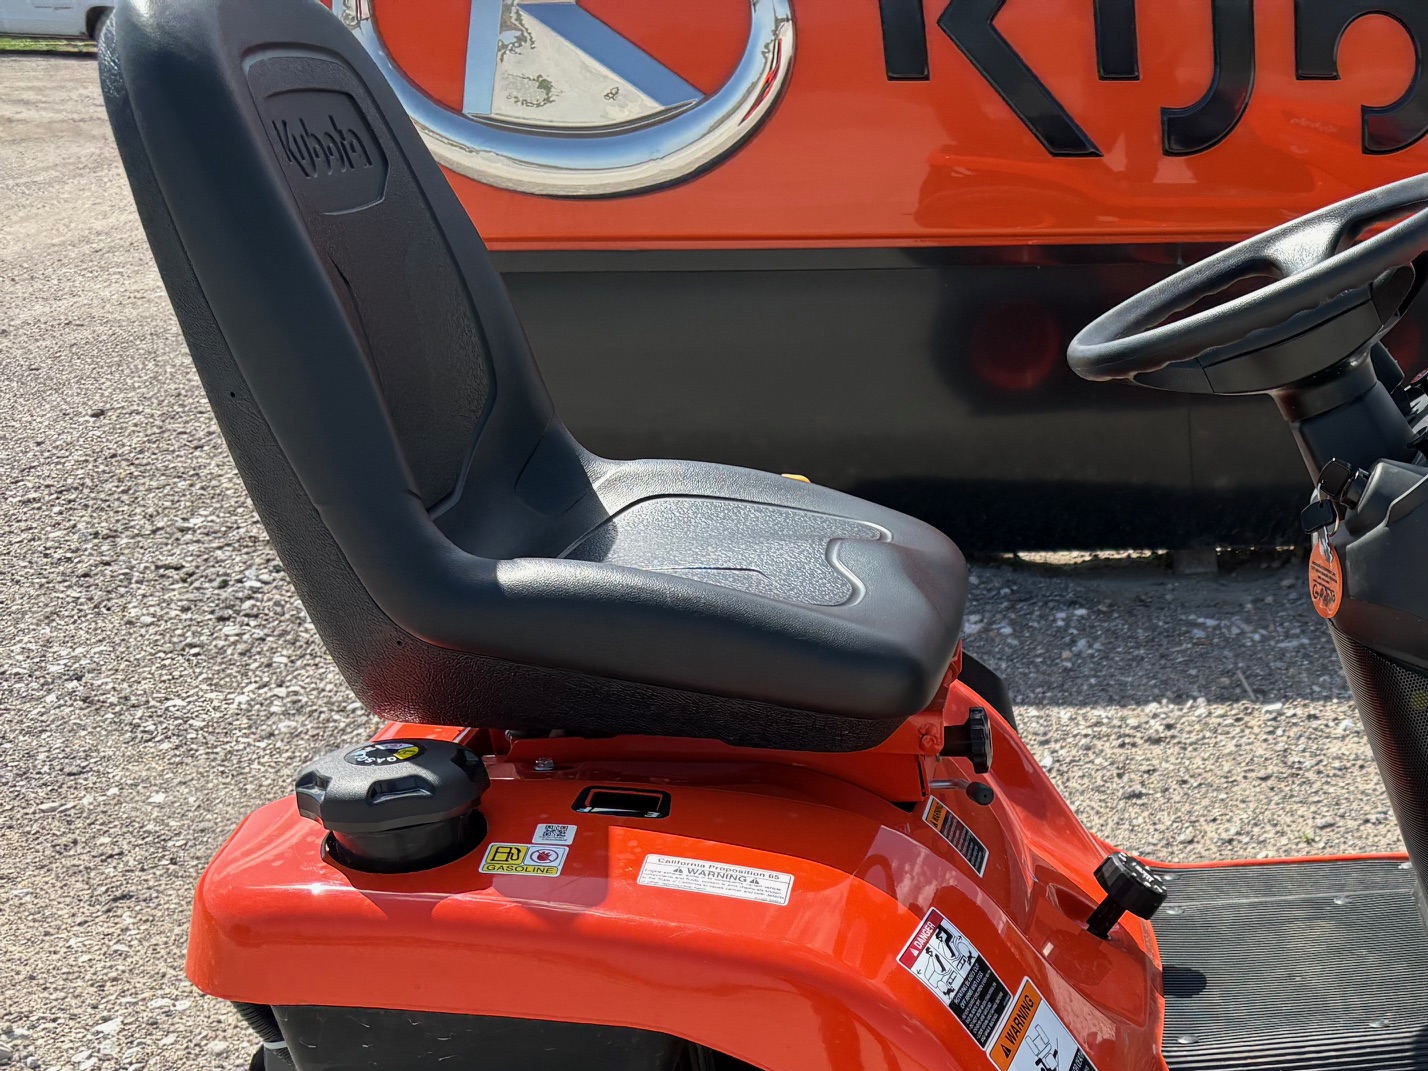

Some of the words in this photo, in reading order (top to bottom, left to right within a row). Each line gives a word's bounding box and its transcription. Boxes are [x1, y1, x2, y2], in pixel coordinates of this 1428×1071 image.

[271, 114, 374, 178] Kubota
[486, 865, 555, 875] GASOLINE
[658, 858, 706, 868] California
[709, 864, 766, 878] Proposition
[768, 872, 780, 880] 65
[687, 868, 747, 882] WARNING
[915, 922, 936, 949] DANGER
[1005, 994, 1034, 1046] WARNING
